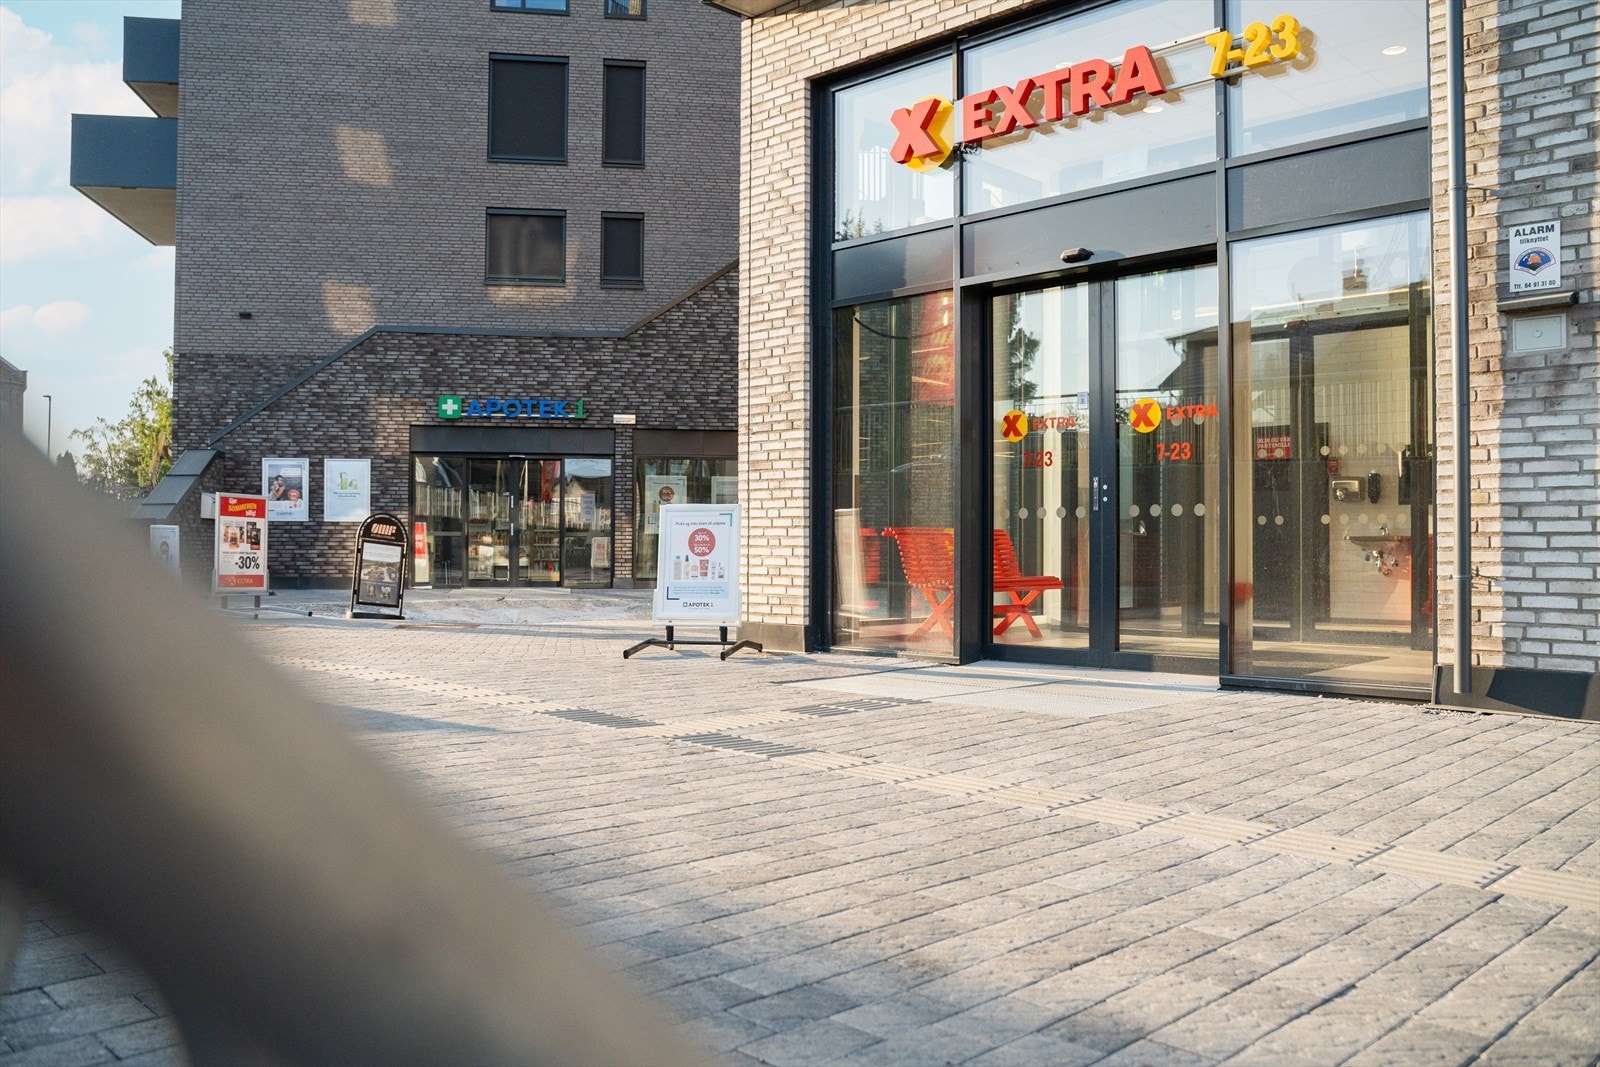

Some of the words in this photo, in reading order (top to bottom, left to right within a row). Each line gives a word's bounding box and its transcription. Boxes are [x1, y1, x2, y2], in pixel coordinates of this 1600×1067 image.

[962, 45, 1167, 143] EXTRA
[1205, 14, 1301, 78] 7-23
[1514, 224, 1555, 237] ALARM
[1519, 235, 1549, 245] tilknyttet
[467, 398, 569, 418] APOTEK
[574, 400, 587, 419] 1
[1166, 403, 1218, 420] EXTRA
[1032, 416, 1076, 431] EXTRA
[1024, 451, 1052, 467] 7-23
[1156, 442, 1191, 461] 7-23
[694, 534, 710, 542] 30%
[694, 546, 710, 554] 50%
[235, 556, 260, 570] -30%
